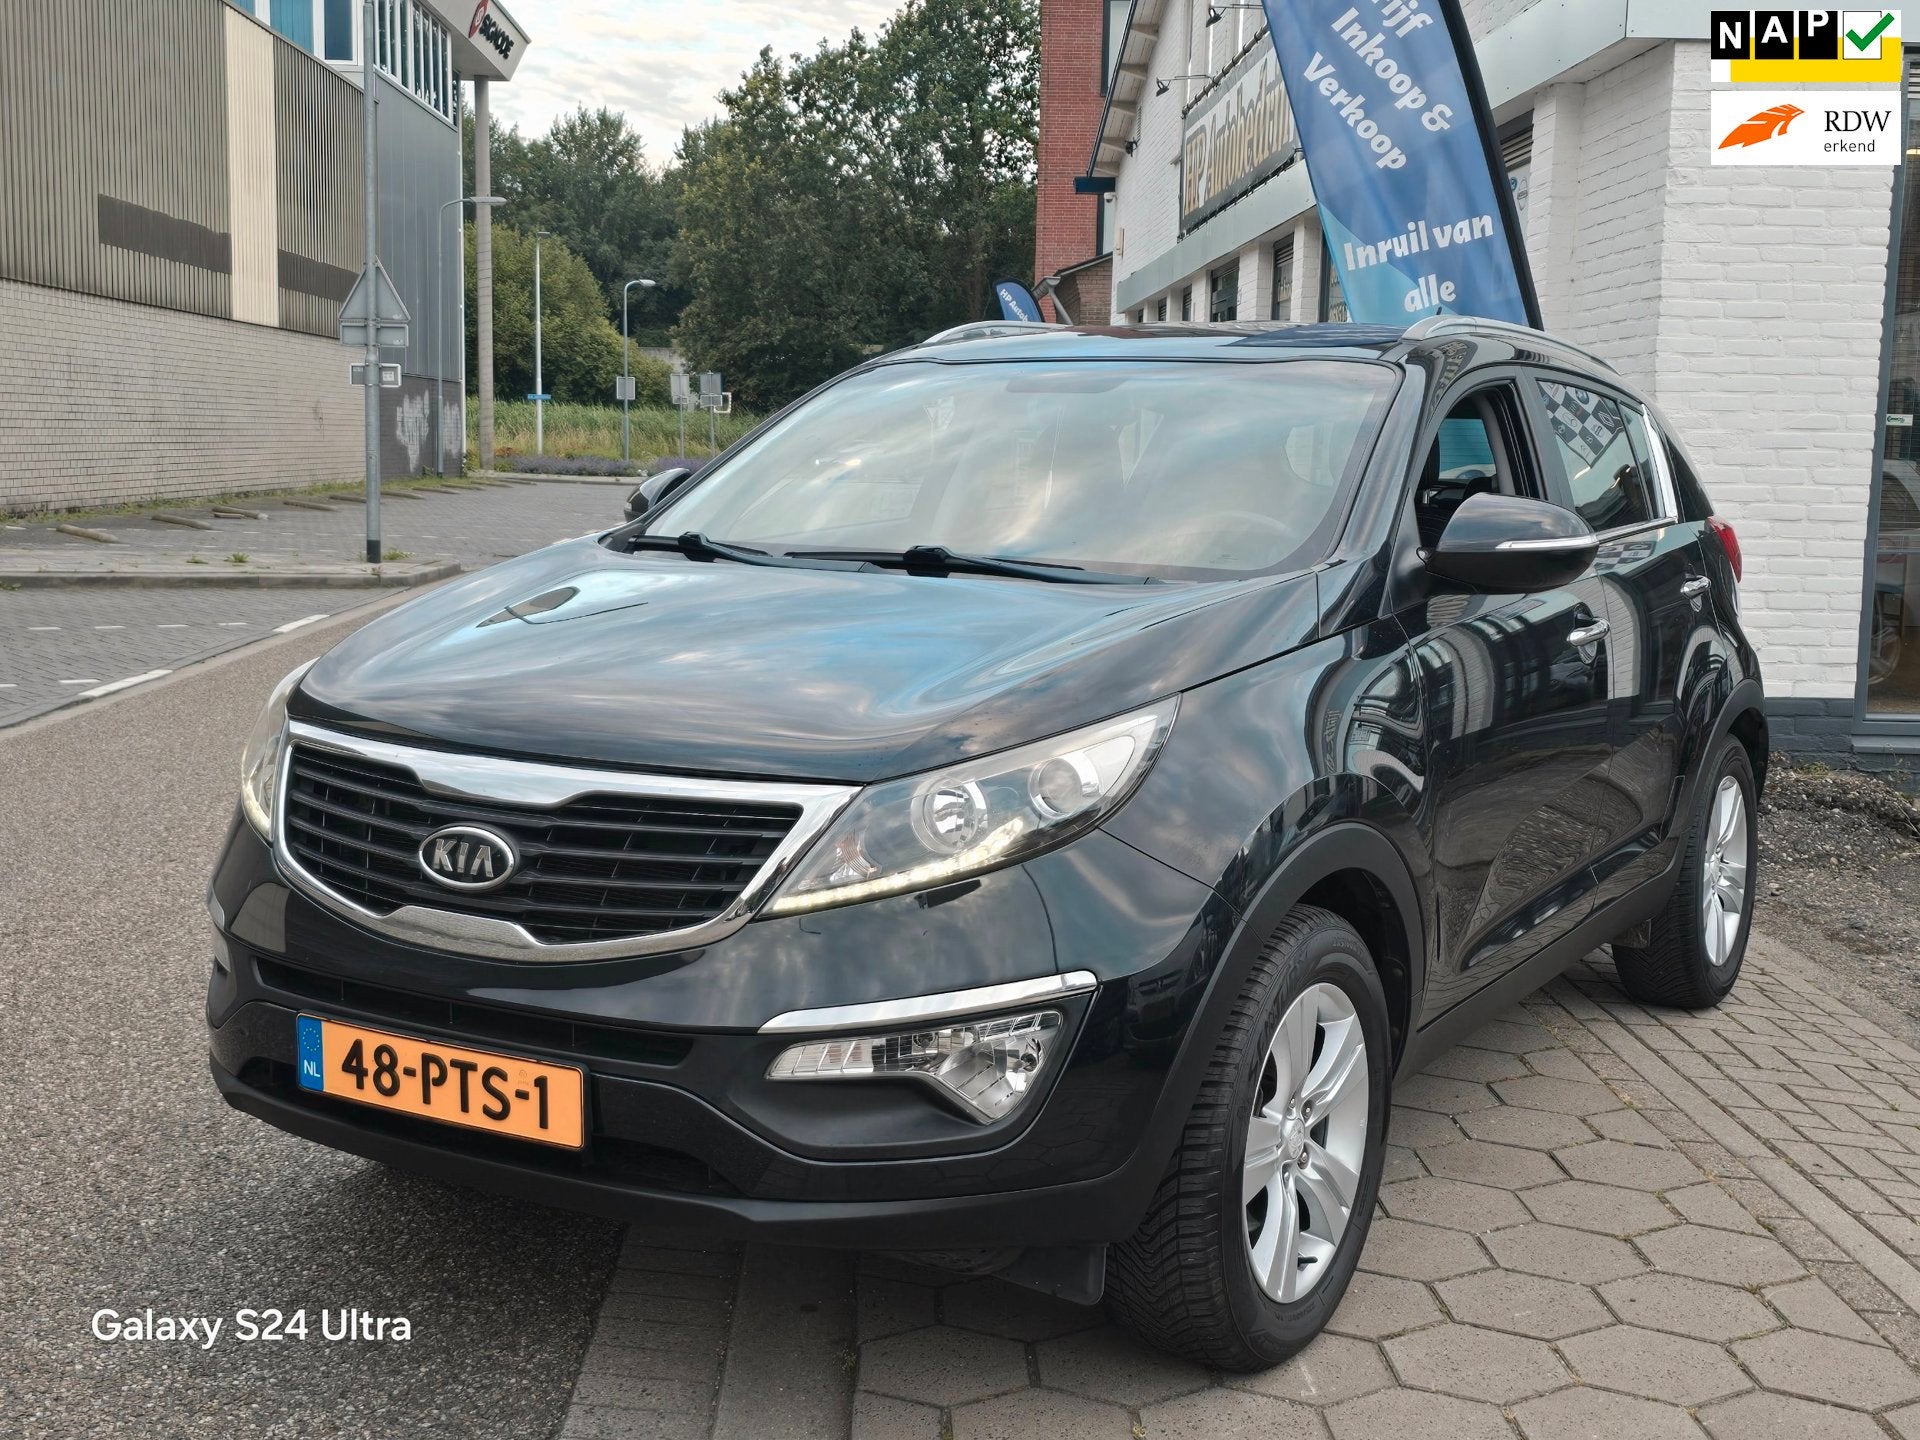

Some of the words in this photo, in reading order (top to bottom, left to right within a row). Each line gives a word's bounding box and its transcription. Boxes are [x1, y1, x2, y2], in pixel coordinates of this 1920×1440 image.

[479, 14, 515, 59] SIGNODE
[1371, 0, 1433, 38] ijf
[1331, 7, 1427, 110] Inkoop
[1421, 103, 1453, 132] &
[1303, 51, 1407, 169] Verkoop
[1184, 126, 1207, 215] HP
[1344, 220, 1429, 271] Inruil
[1432, 214, 1494, 248] van
[1000, 288, 1012, 301] HP
[1404, 274, 1456, 313] alle
[432, 838, 494, 878] KIA
[303, 1059, 321, 1078] NL
[341, 1038, 549, 1130] 48-PTS-1
